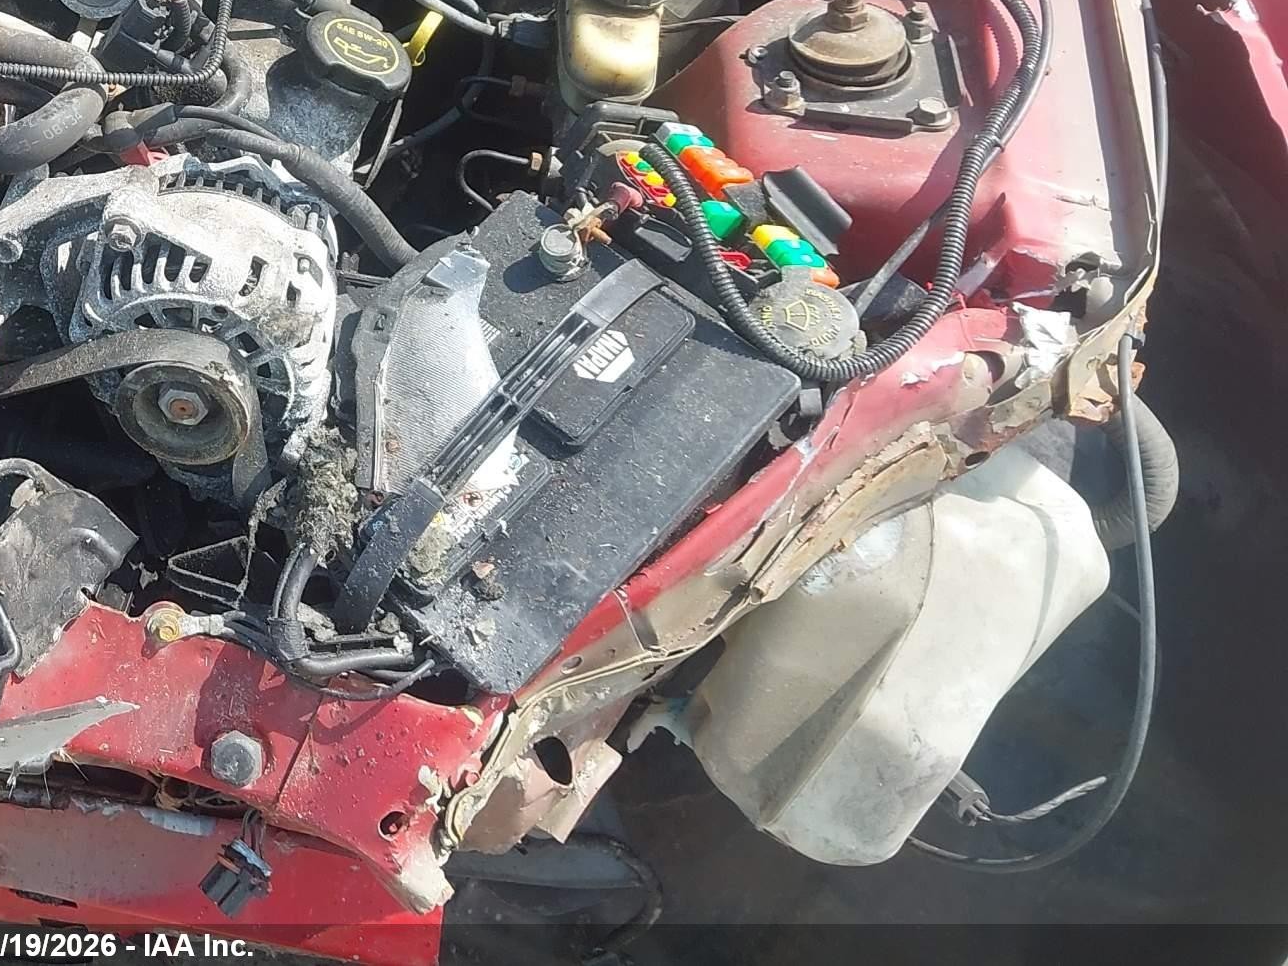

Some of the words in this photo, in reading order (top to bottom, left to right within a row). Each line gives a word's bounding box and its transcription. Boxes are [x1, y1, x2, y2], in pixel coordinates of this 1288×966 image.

[336, 23, 356, 35] SAE
[357, 30, 388, 49] 5W-20
[806, 289, 842, 322] WASHER
[810, 323, 841, 347] FLUID
[576, 332, 626, 379] NAPA
